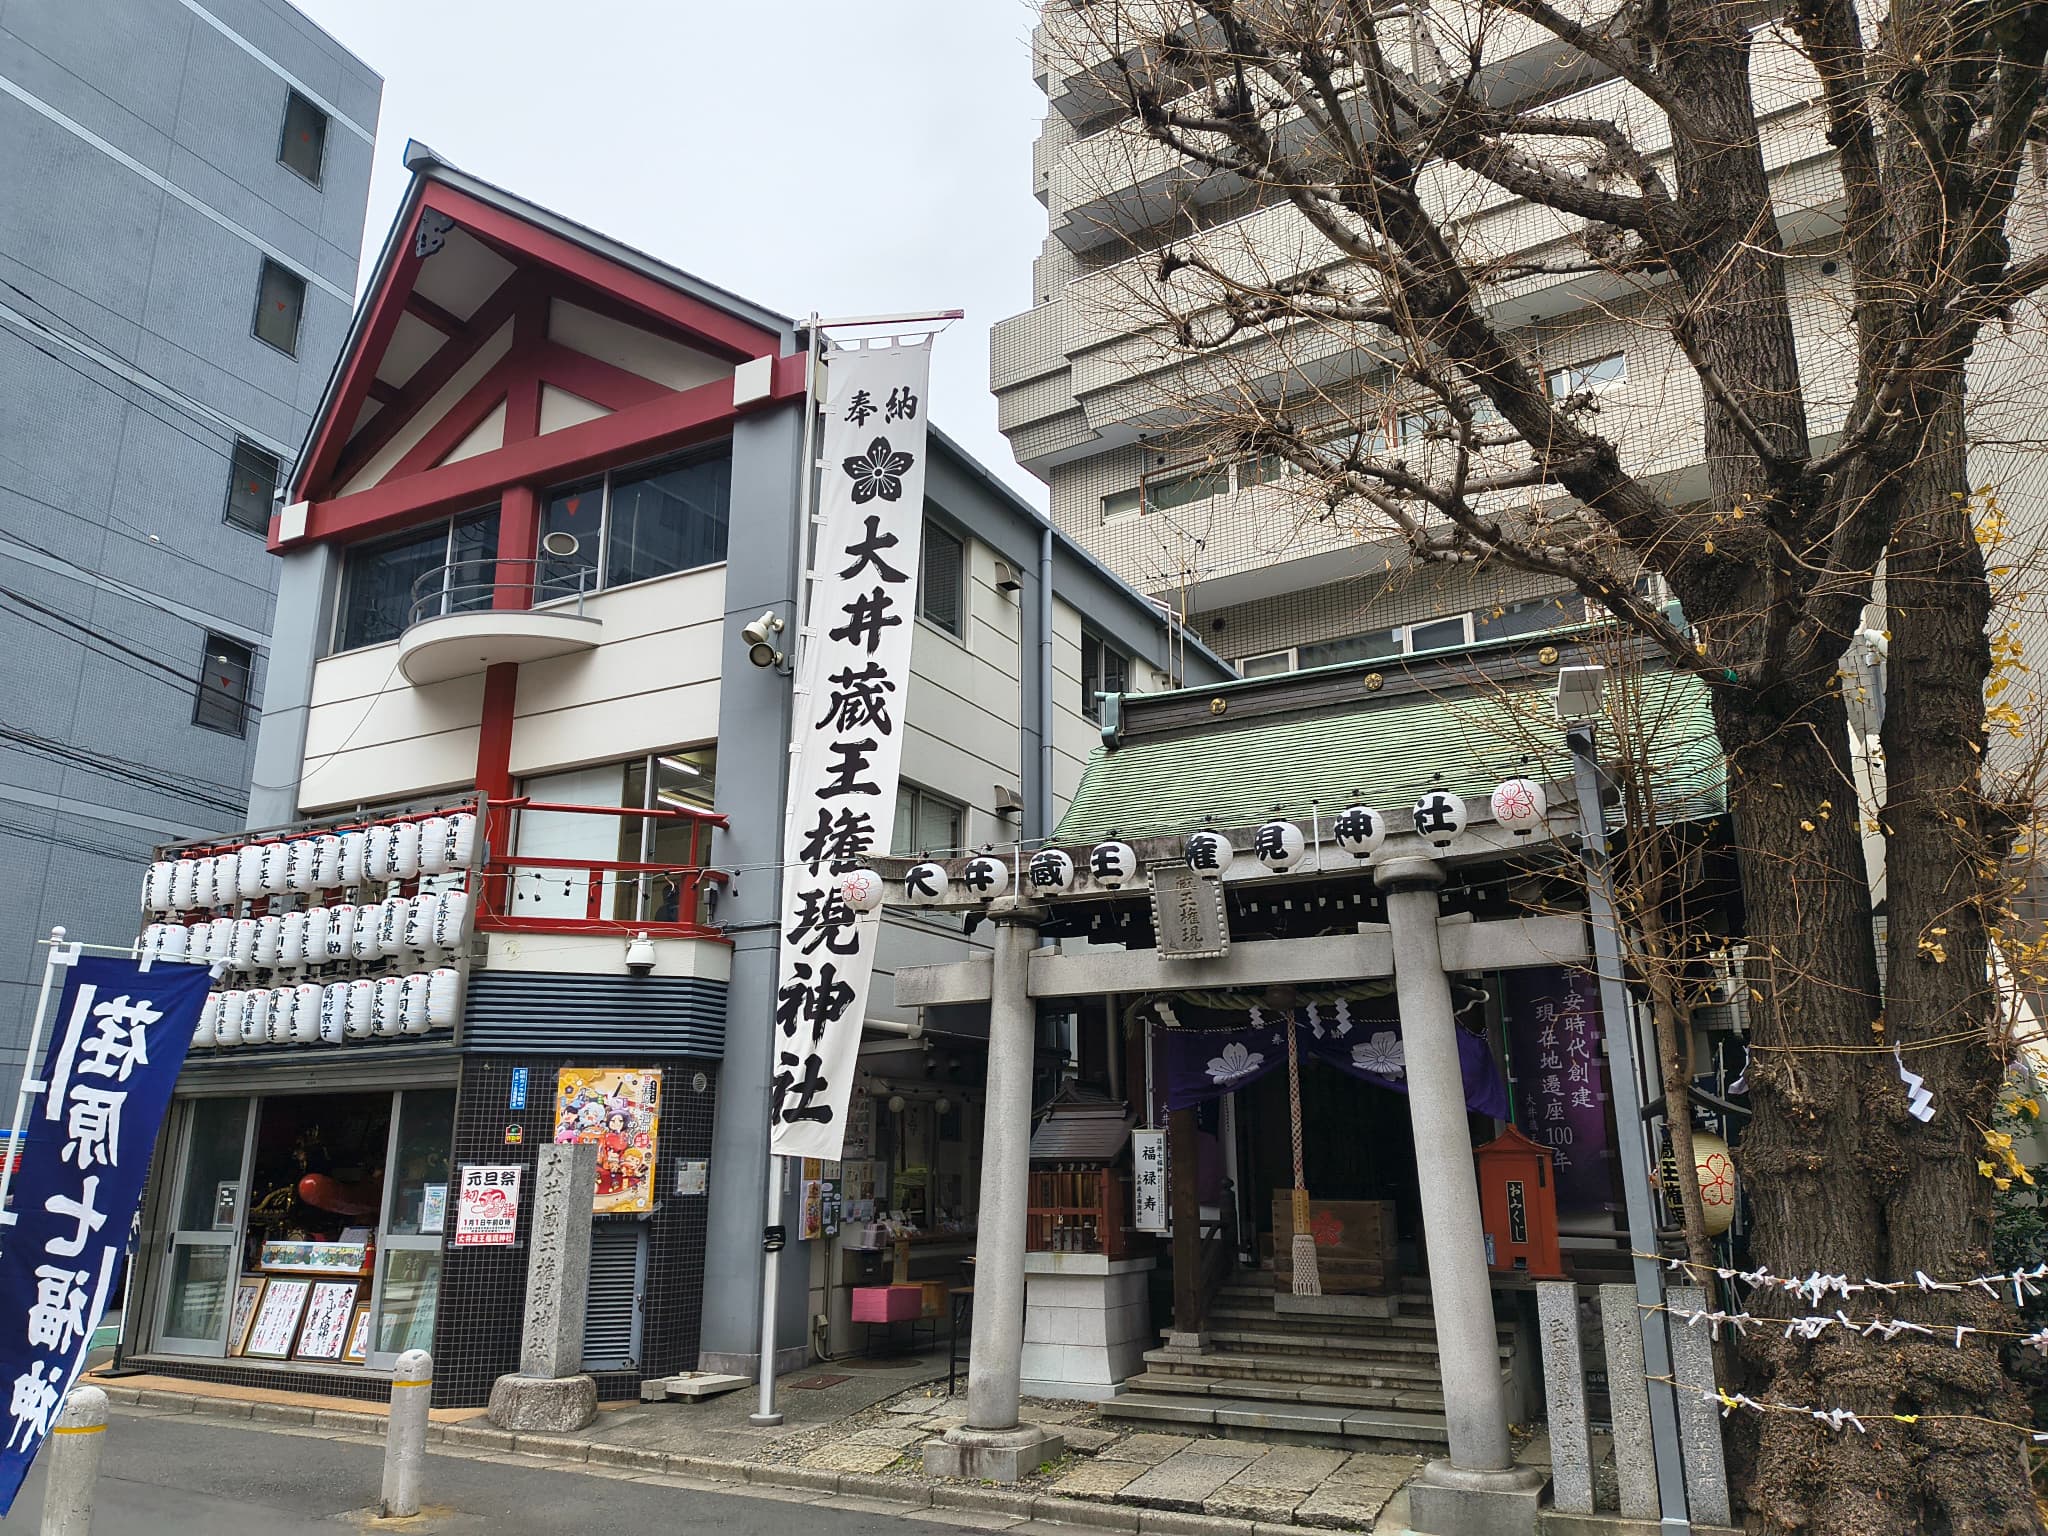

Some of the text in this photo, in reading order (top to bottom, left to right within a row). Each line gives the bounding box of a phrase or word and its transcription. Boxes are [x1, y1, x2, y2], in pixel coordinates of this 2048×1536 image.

[843, 386, 918, 428] 奉納
[771, 515, 912, 1126] 大井蔵王権現神社
[906, 867, 938, 899] 大
[965, 861, 994, 891] 井
[1029, 854, 1066, 888] 蔵
[1091, 845, 1122, 877] 王
[1334, 810, 1372, 847] 神
[1414, 796, 1457, 834] 社
[260, 847, 271, 889] 山下正人
[1562, 968, 1594, 1109] 平安時代創建
[467, 1171, 516, 1186] 元旦祭
[1142, 1146, 1156, 1211] 福禄寿
[1508, 1184, 1526, 1241] おみくじ
